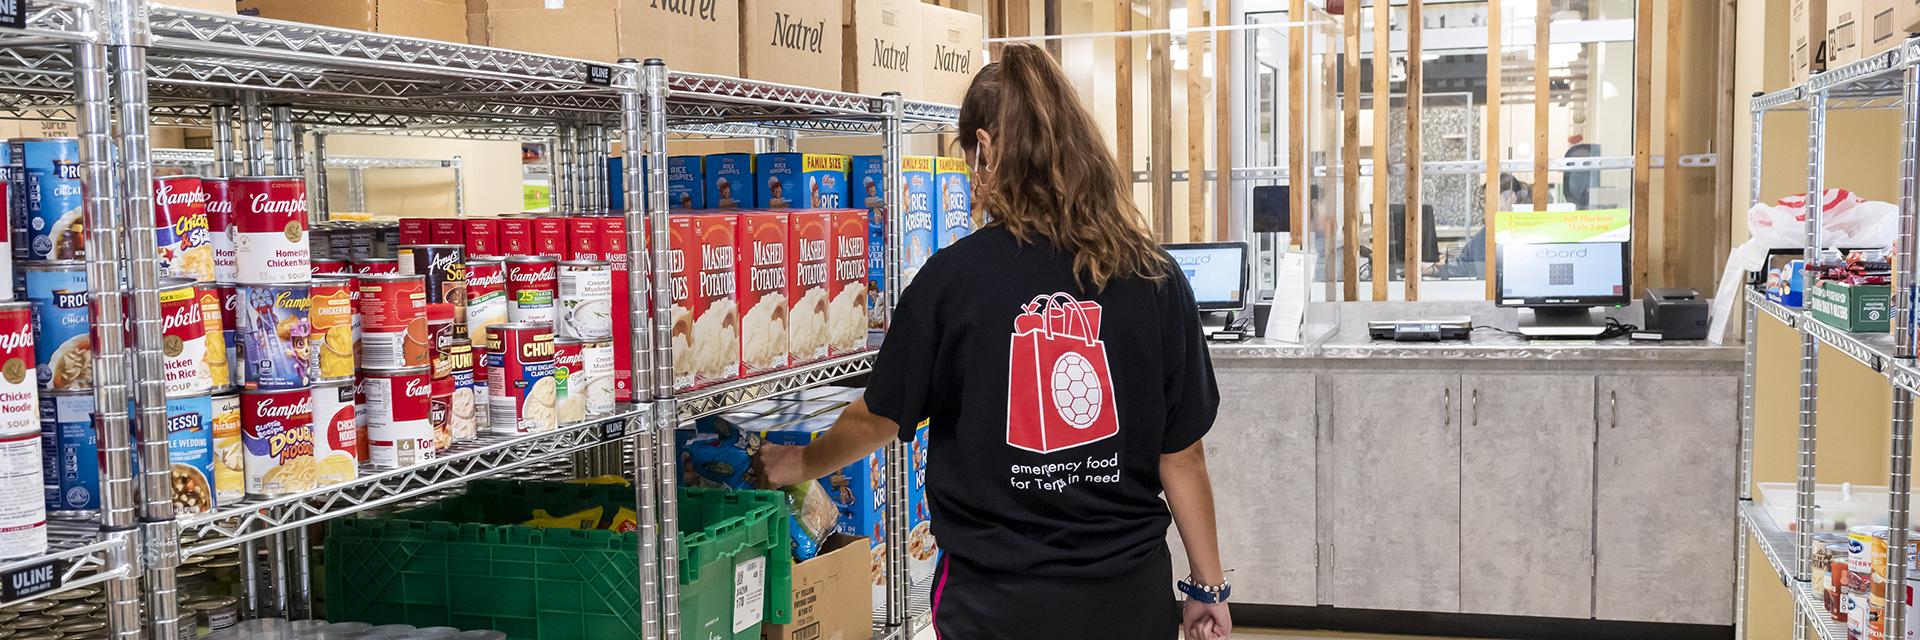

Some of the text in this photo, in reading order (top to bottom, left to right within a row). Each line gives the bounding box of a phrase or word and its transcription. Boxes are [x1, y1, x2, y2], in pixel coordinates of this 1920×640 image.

[650, 0, 717, 22] atrel
[771, 12, 824, 54] Natrel
[872, 38, 911, 74] Natrel
[933, 44, 971, 75] Natrel
[592, 66, 608, 79] ULINE
[807, 157, 842, 169] FAMILY SIZE
[821, 194, 839, 210] RICE
[911, 192, 928, 212] RICE
[702, 244, 735, 272] MASHED
[752, 240, 785, 267] MASHED
[799, 237, 827, 262] MASHED
[838, 234, 865, 260] MASHED
[1535, 247, 1588, 259] cbord
[267, 259, 298, 268] Chicken
[428, 250, 460, 277] Amy's
[797, 261, 828, 287] POTATOES
[835, 257, 867, 282] POTATOES
[288, 272, 305, 280] SOUP
[699, 271, 737, 298] POTATOES
[750, 265, 786, 292] POTATOES
[178, 368, 197, 380] Rice
[0, 391, 32, 402] Chicken
[165, 382, 192, 393] SOUP
[7, 419, 31, 429] SOUP
[605, 420, 623, 435] ULINE
[402, 440, 409, 450] 6
[1087, 453, 1119, 469] food
[1010, 477, 1031, 491] for
[1068, 473, 1080, 485] in
[1085, 469, 1121, 484] need
[12, 564, 54, 590] ULINE
